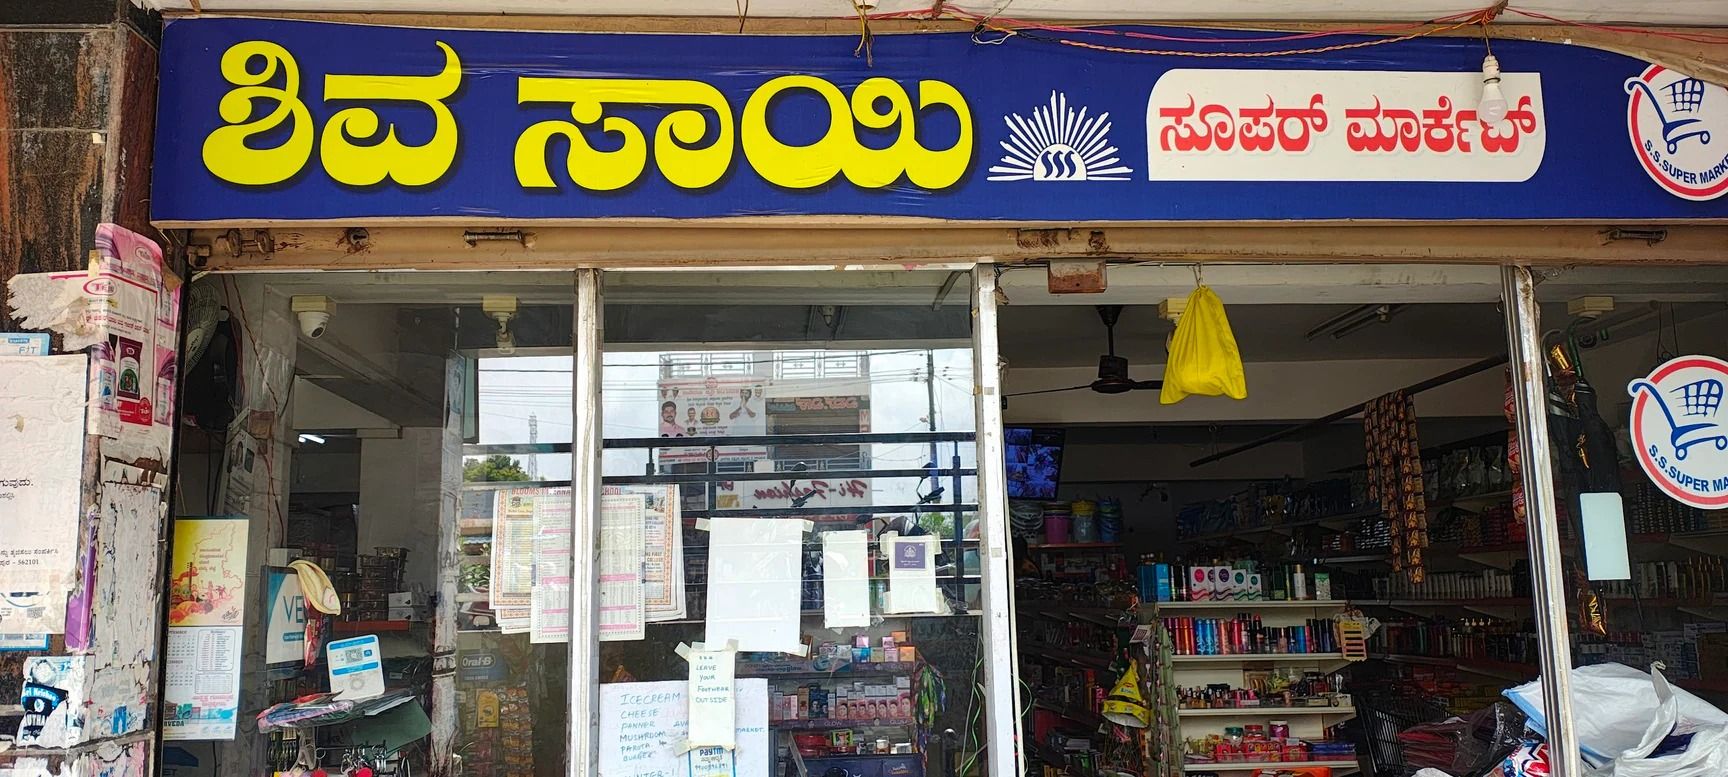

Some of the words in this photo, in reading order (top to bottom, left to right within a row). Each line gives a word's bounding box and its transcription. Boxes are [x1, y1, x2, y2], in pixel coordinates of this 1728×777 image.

[202, 40, 462, 187] ಶಿವ
[514, 75, 973, 190] ಸಾಯಿ
[1158, 92, 1329, 153] ಸೂಪರ್
[462, 656, 492, 667] Oral-B
[699, 674, 716, 682] YOUR
[620, 692, 681, 705] ICECREAM
[621, 708, 658, 719] CHEESE
